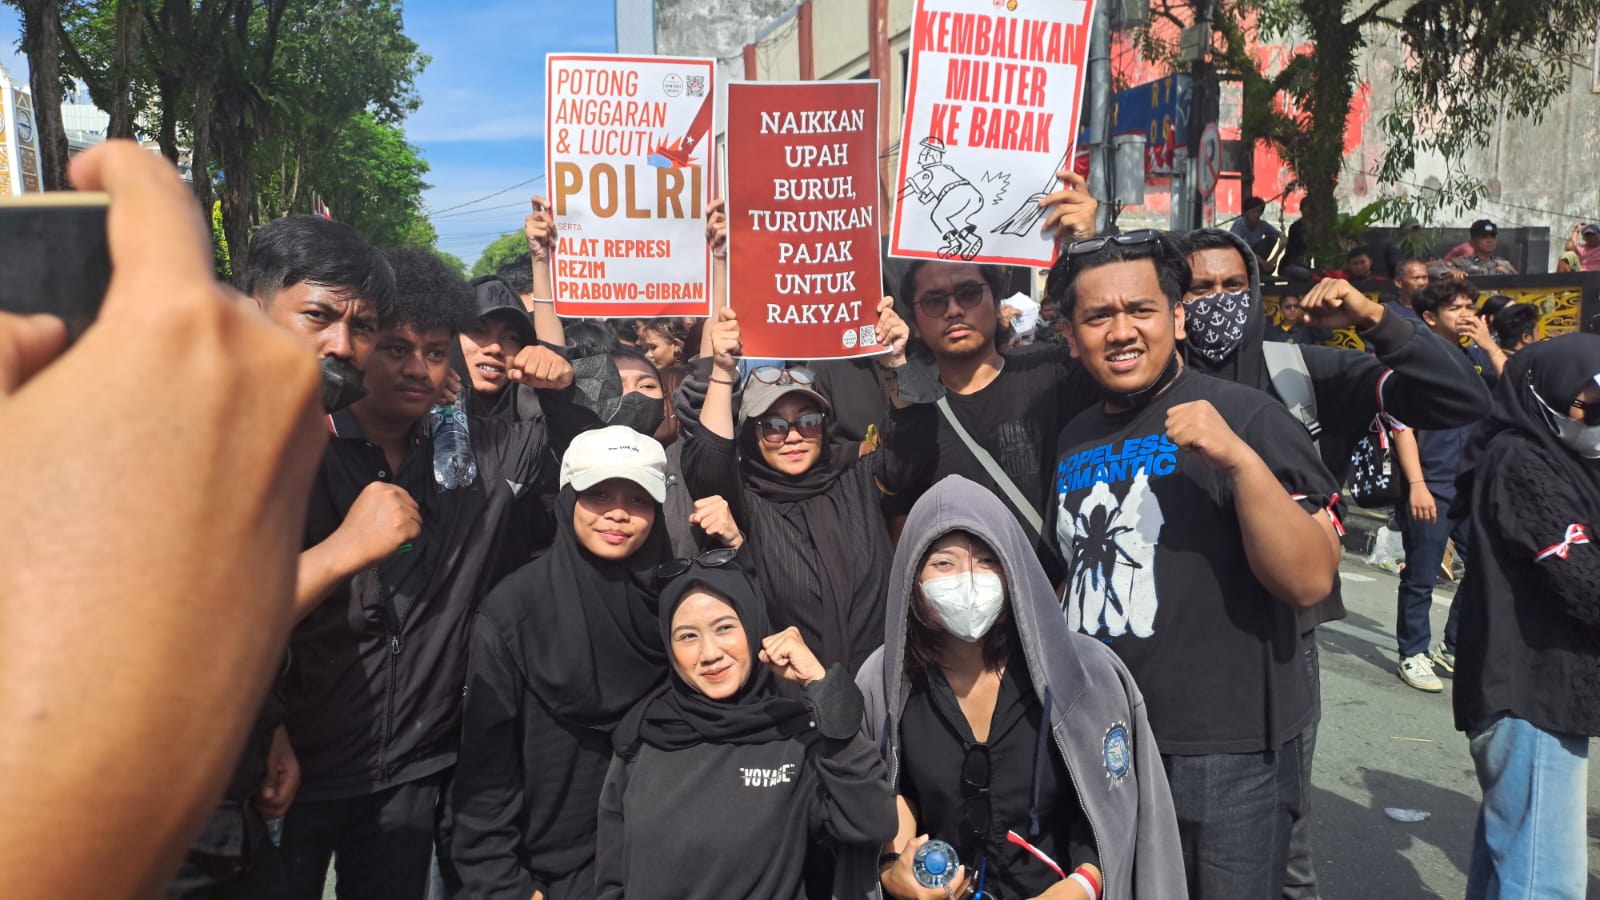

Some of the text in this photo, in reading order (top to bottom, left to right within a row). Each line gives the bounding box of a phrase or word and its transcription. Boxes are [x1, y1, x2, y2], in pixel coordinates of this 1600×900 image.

[918, 11, 1083, 65] KEMBALIKAN
[557, 68, 638, 97] POTONG
[946, 58, 1047, 107] MILITER
[555, 99, 667, 128] ANGGARAN
[760, 109, 864, 134] NAIKKAN
[928, 103, 1054, 153] KE BARAK
[556, 127, 653, 157] & LUCUTI
[785, 143, 848, 168] UPAH
[555, 161, 701, 219] POLRI
[773, 176, 856, 200] BURUH,
[557, 223, 582, 231] SERTA
[748, 205, 873, 232] TURUNKAN
[557, 237, 671, 258] ALAT REPRESI
[778, 240, 853, 264] PAJAK
[558, 260, 605, 279] REZIM
[559, 281, 703, 300] PRABOWO-GIBRAN
[775, 271, 856, 294] UNTUK
[767, 300, 862, 324] RAKYAT
[1058, 433, 1179, 476] HOPELESS
